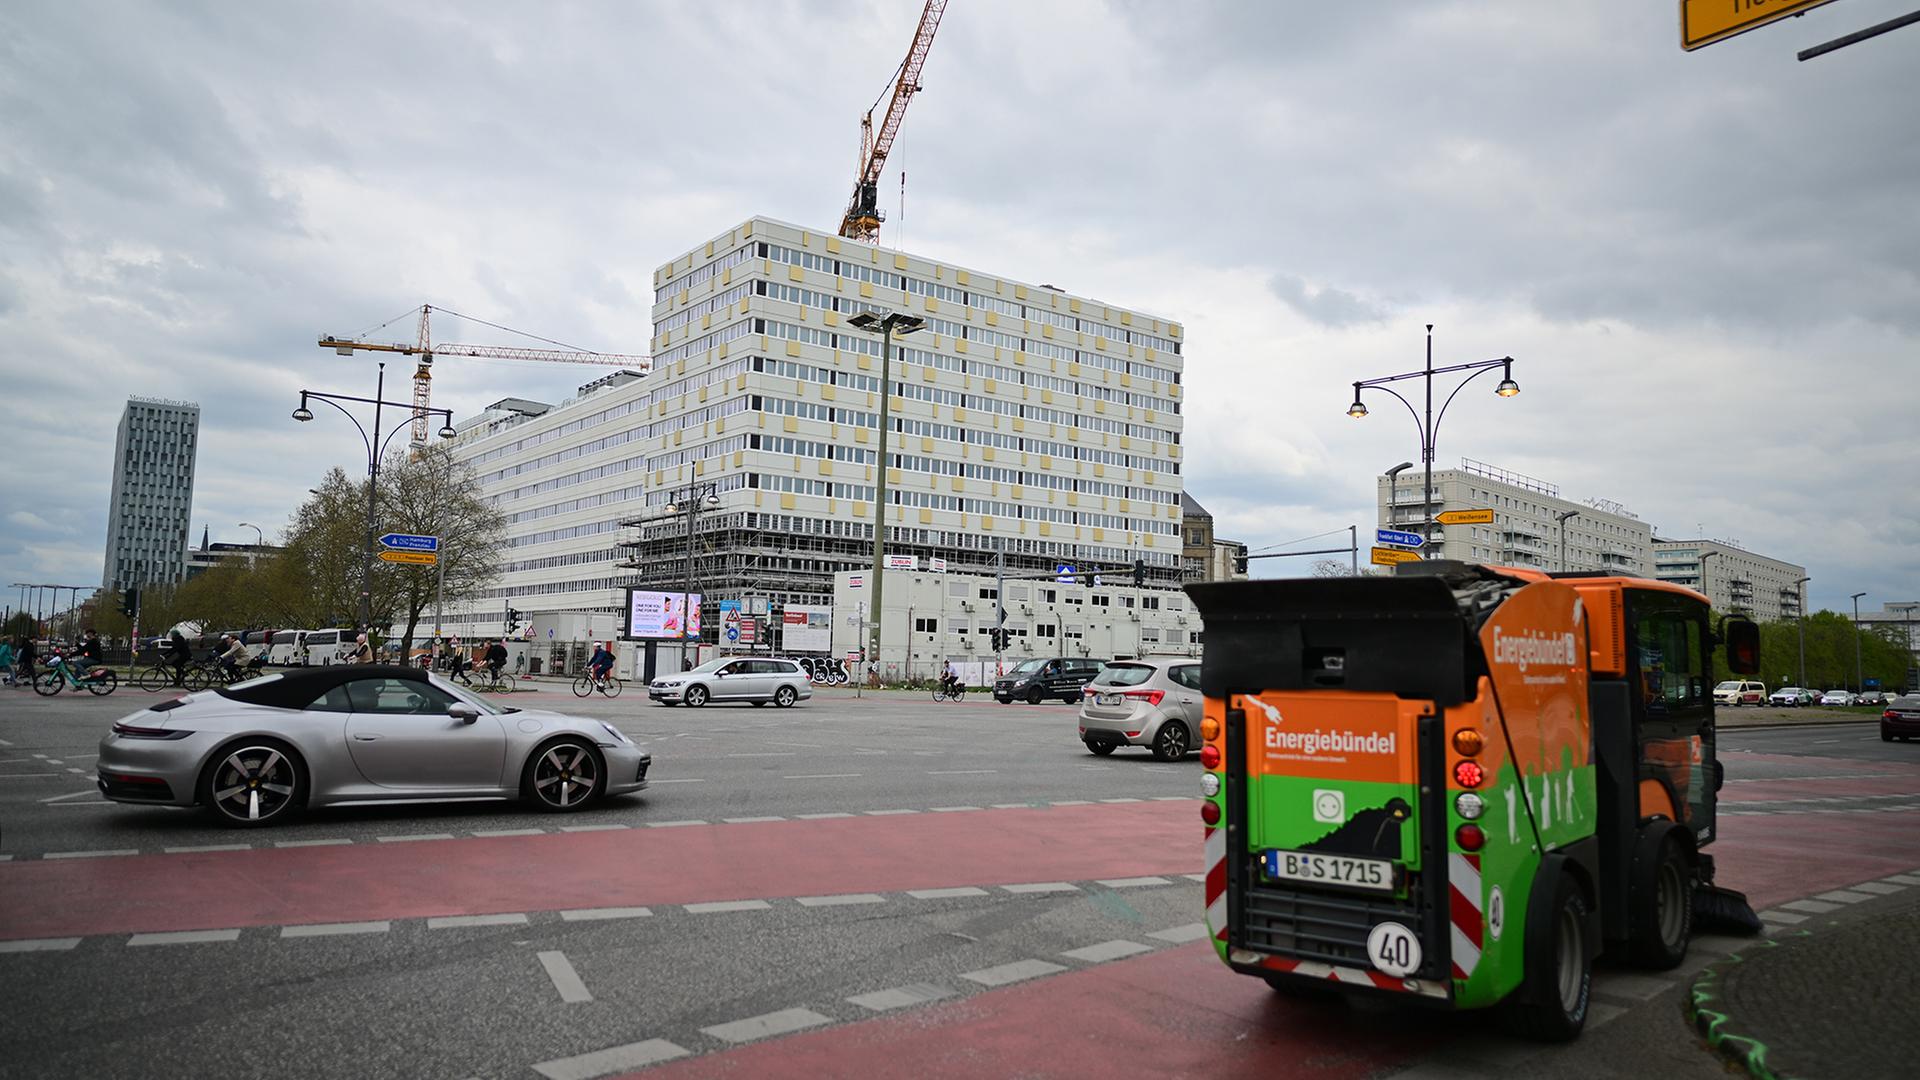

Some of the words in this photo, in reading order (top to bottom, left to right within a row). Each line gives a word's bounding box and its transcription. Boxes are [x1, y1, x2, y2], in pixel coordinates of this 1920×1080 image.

[1494, 626, 1567, 672] Energiebündel
[1265, 726, 1396, 755] Energiebündel
[1286, 855, 1299, 875] B
[1312, 858, 1325, 878] S
[1330, 860, 1382, 885] 1715
[1379, 933, 1410, 968] 40
